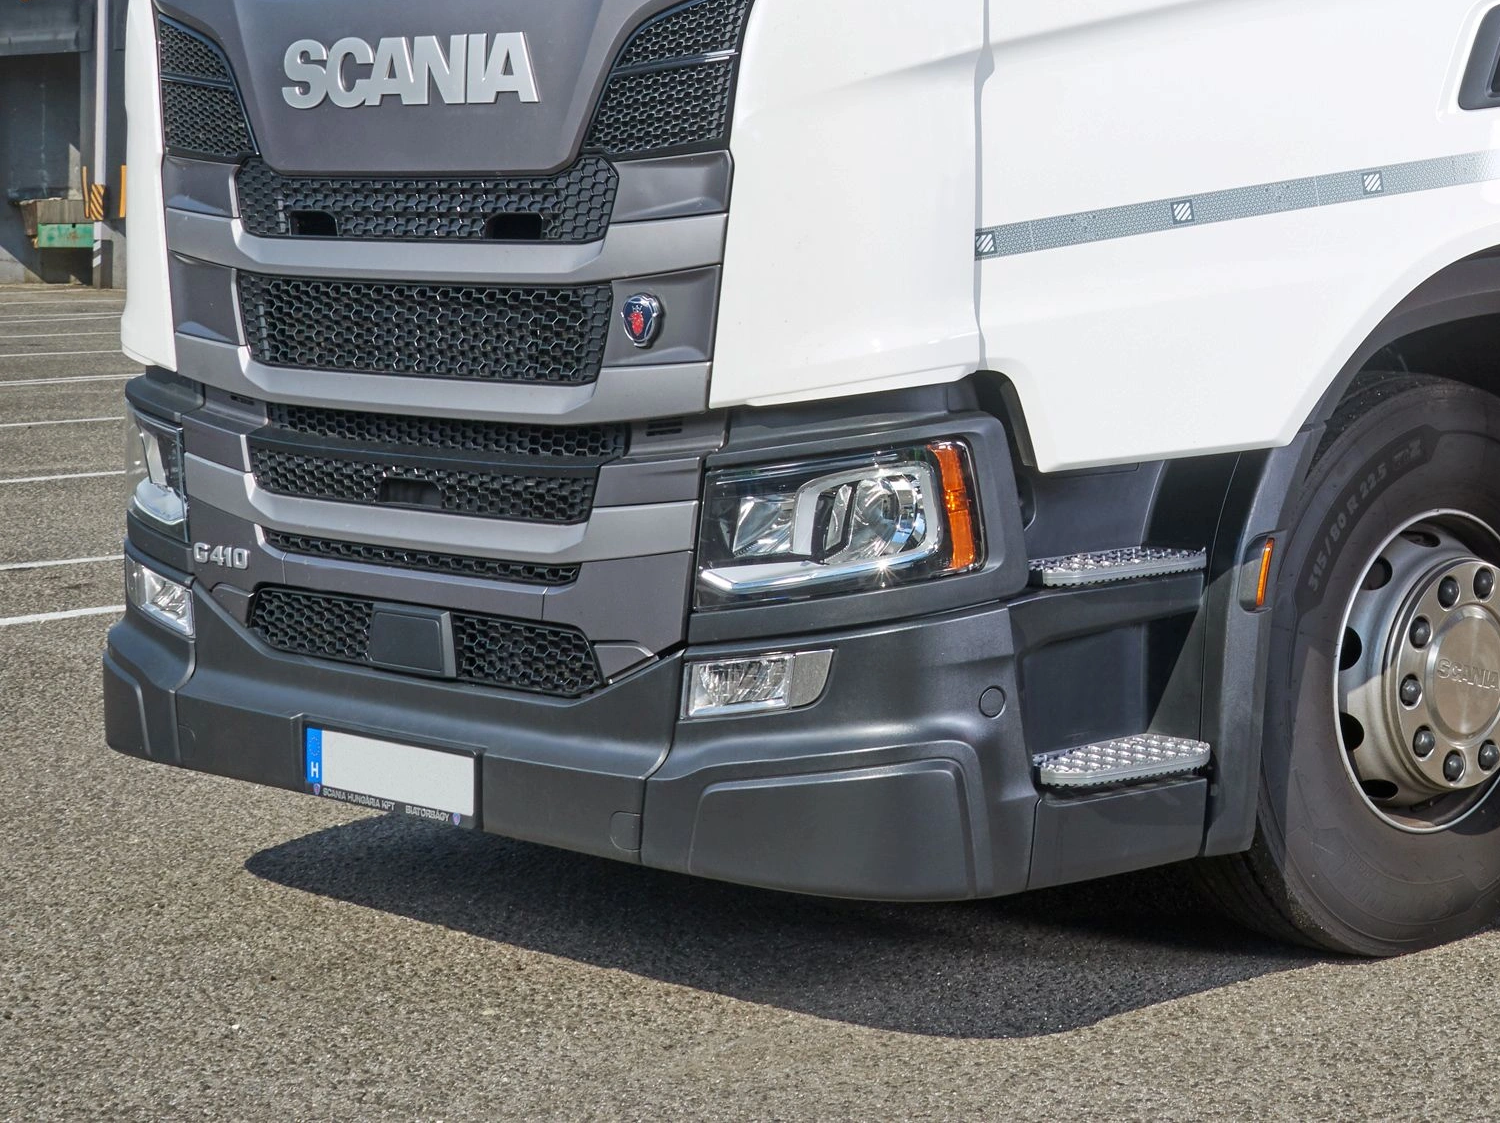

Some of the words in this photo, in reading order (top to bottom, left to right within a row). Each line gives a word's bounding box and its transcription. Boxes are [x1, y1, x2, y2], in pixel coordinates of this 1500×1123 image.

[281, 31, 540, 110] SCANIA
[193, 541, 249, 570] G410
[1437, 658, 1500, 692] SCANIA
[310, 761, 319, 778] H
[322, 787, 346, 801] SCANIA
